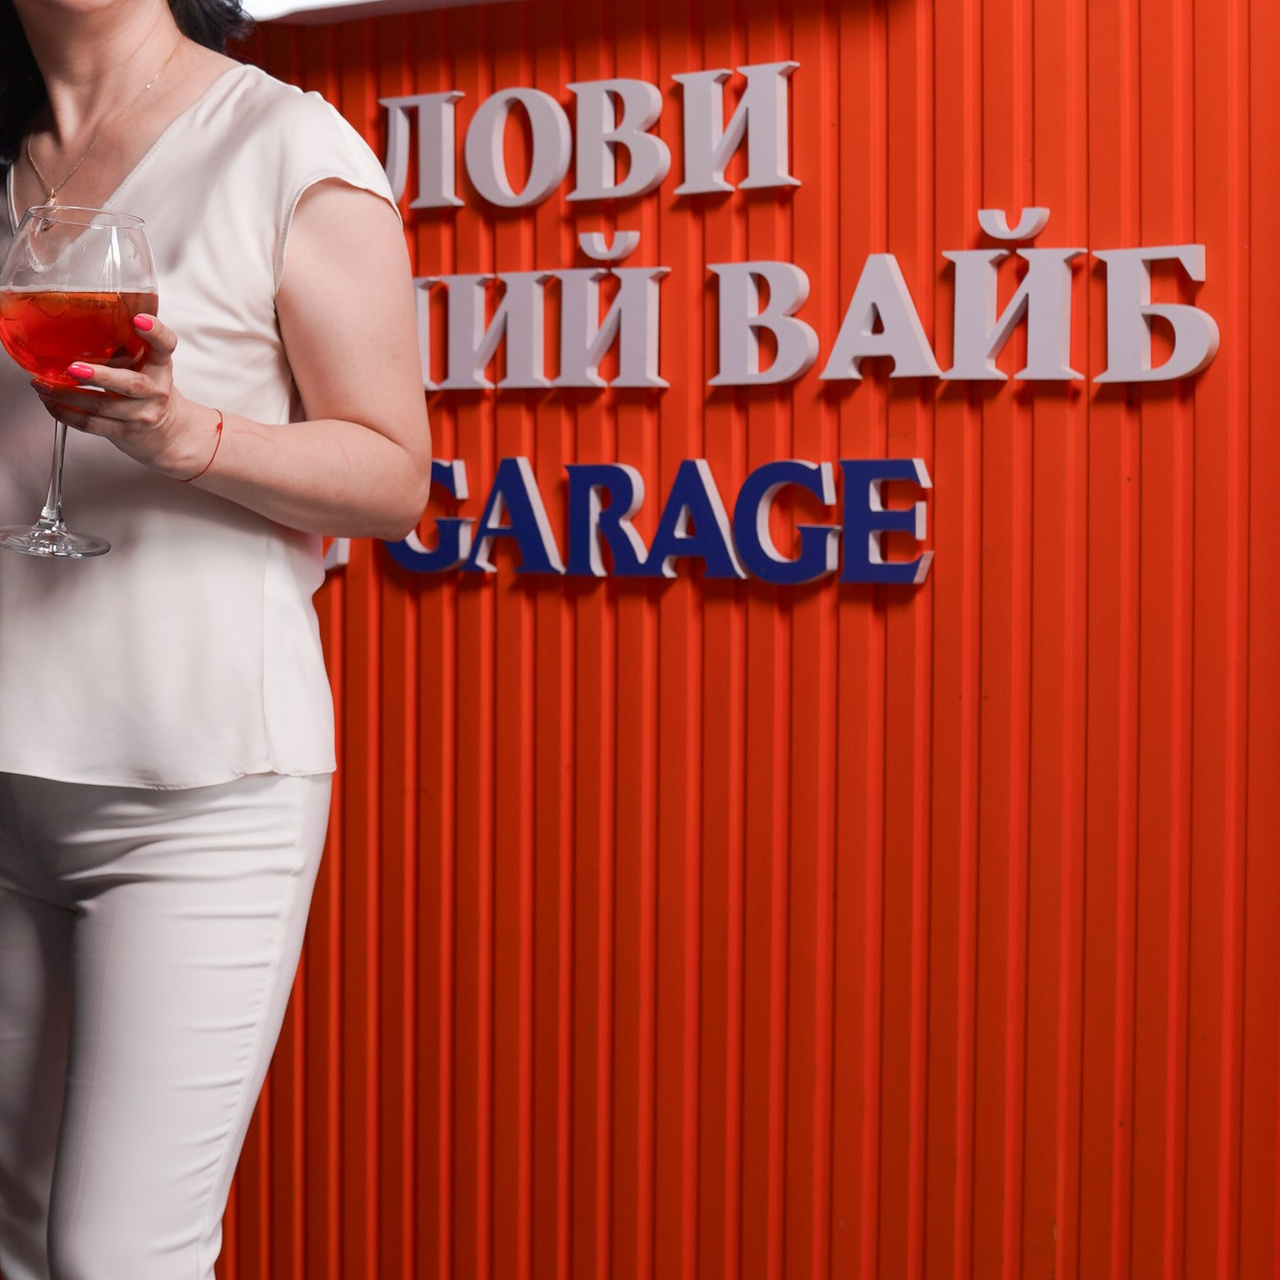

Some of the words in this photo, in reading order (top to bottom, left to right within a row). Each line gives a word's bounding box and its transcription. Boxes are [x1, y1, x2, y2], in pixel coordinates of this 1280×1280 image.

[378, 60, 801, 210] ЛОВИ
[707, 206, 1220, 386] ВАЙБ
[384, 456, 934, 585] GARAGE
